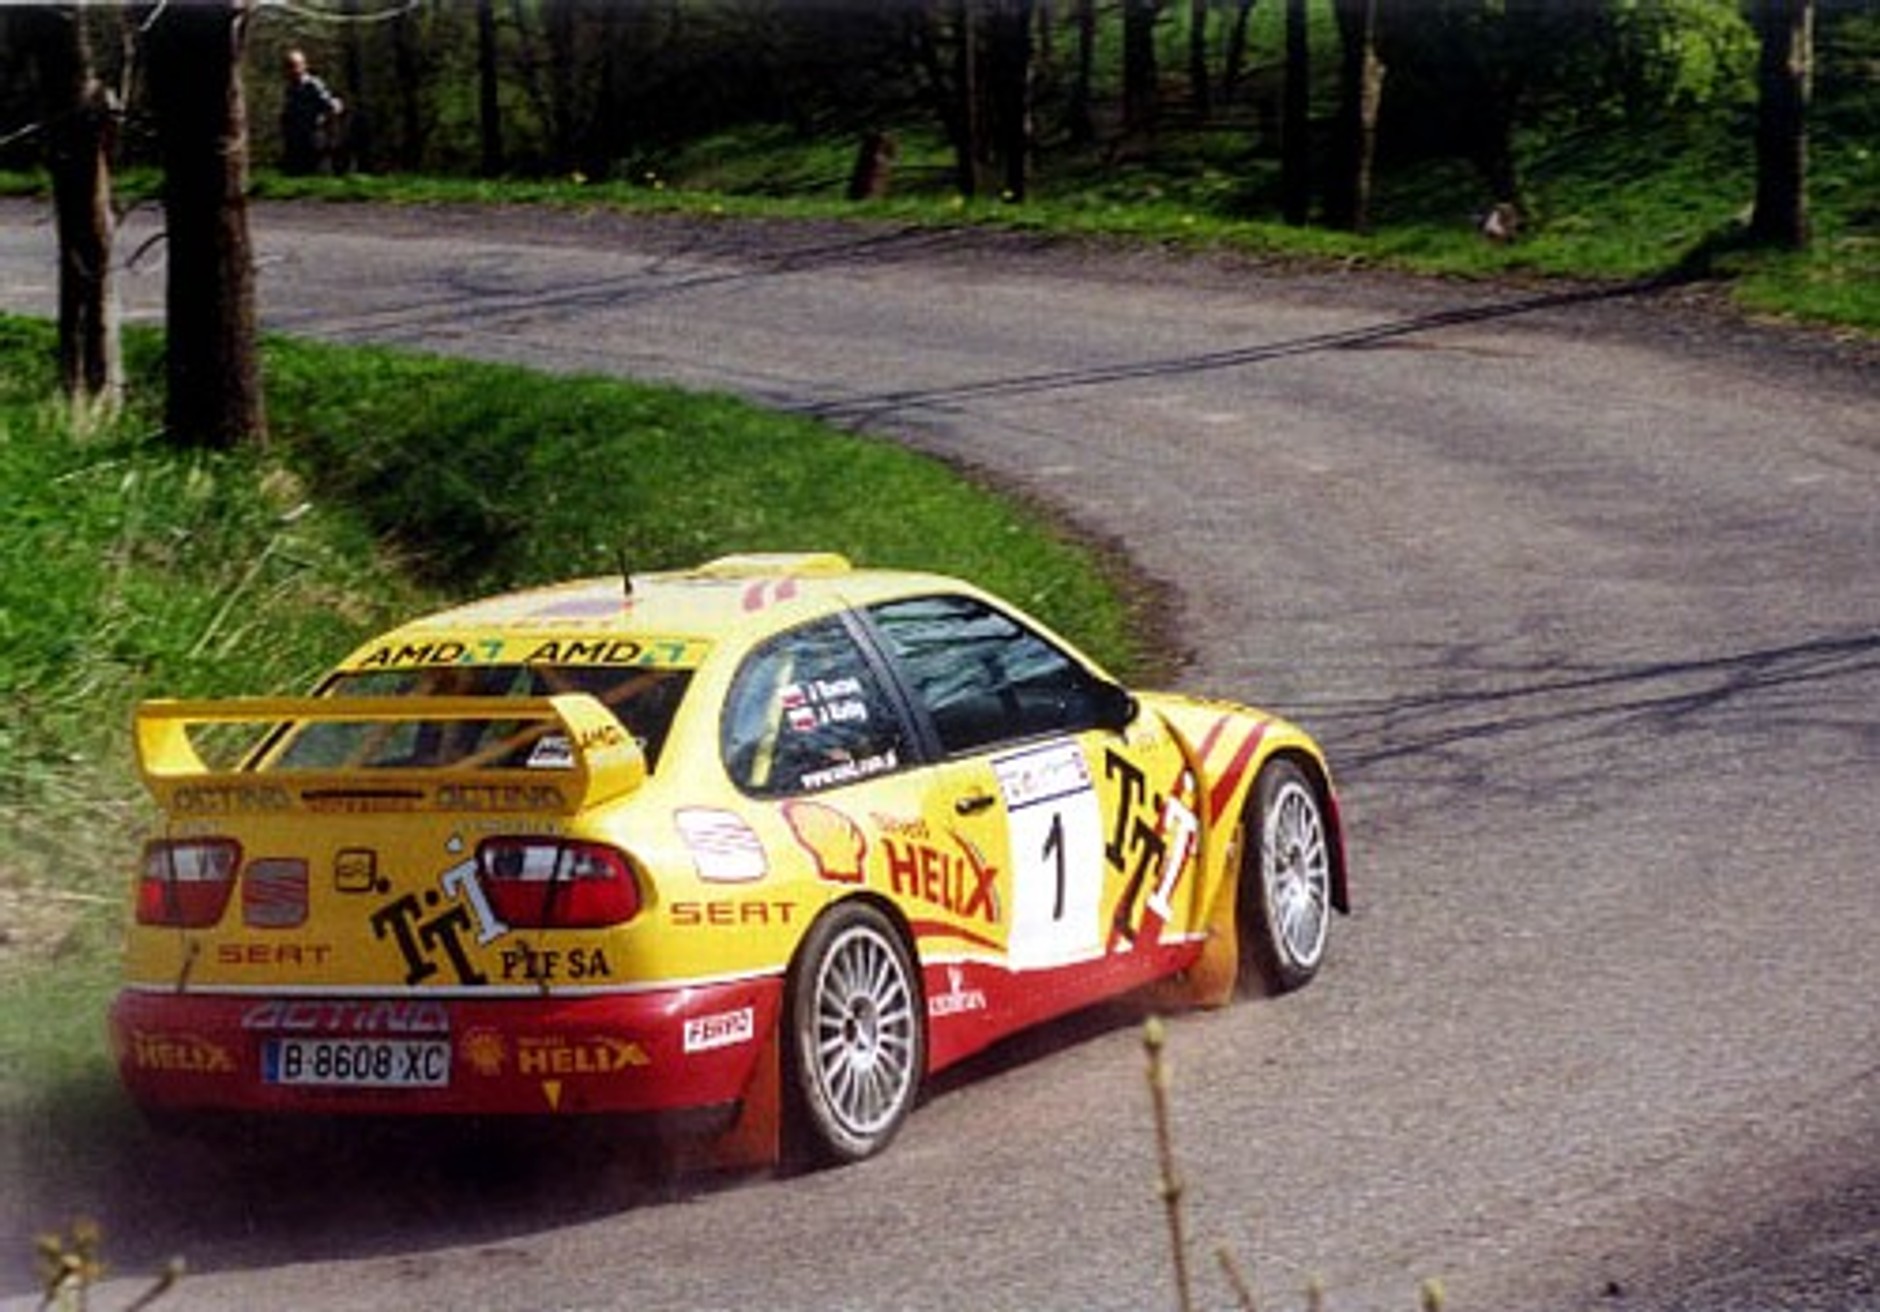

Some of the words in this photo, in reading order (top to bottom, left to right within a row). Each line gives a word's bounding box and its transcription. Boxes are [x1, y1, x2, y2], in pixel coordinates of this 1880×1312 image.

[360, 642, 463, 667] AMD
[523, 642, 641, 664] AMD
[1041, 811, 1066, 922] 1
[879, 836, 1000, 924] HELIX
[669, 900, 796, 926] SEAT
[216, 943, 331, 965] SEAT
[516, 1043, 651, 1074] HELIX
